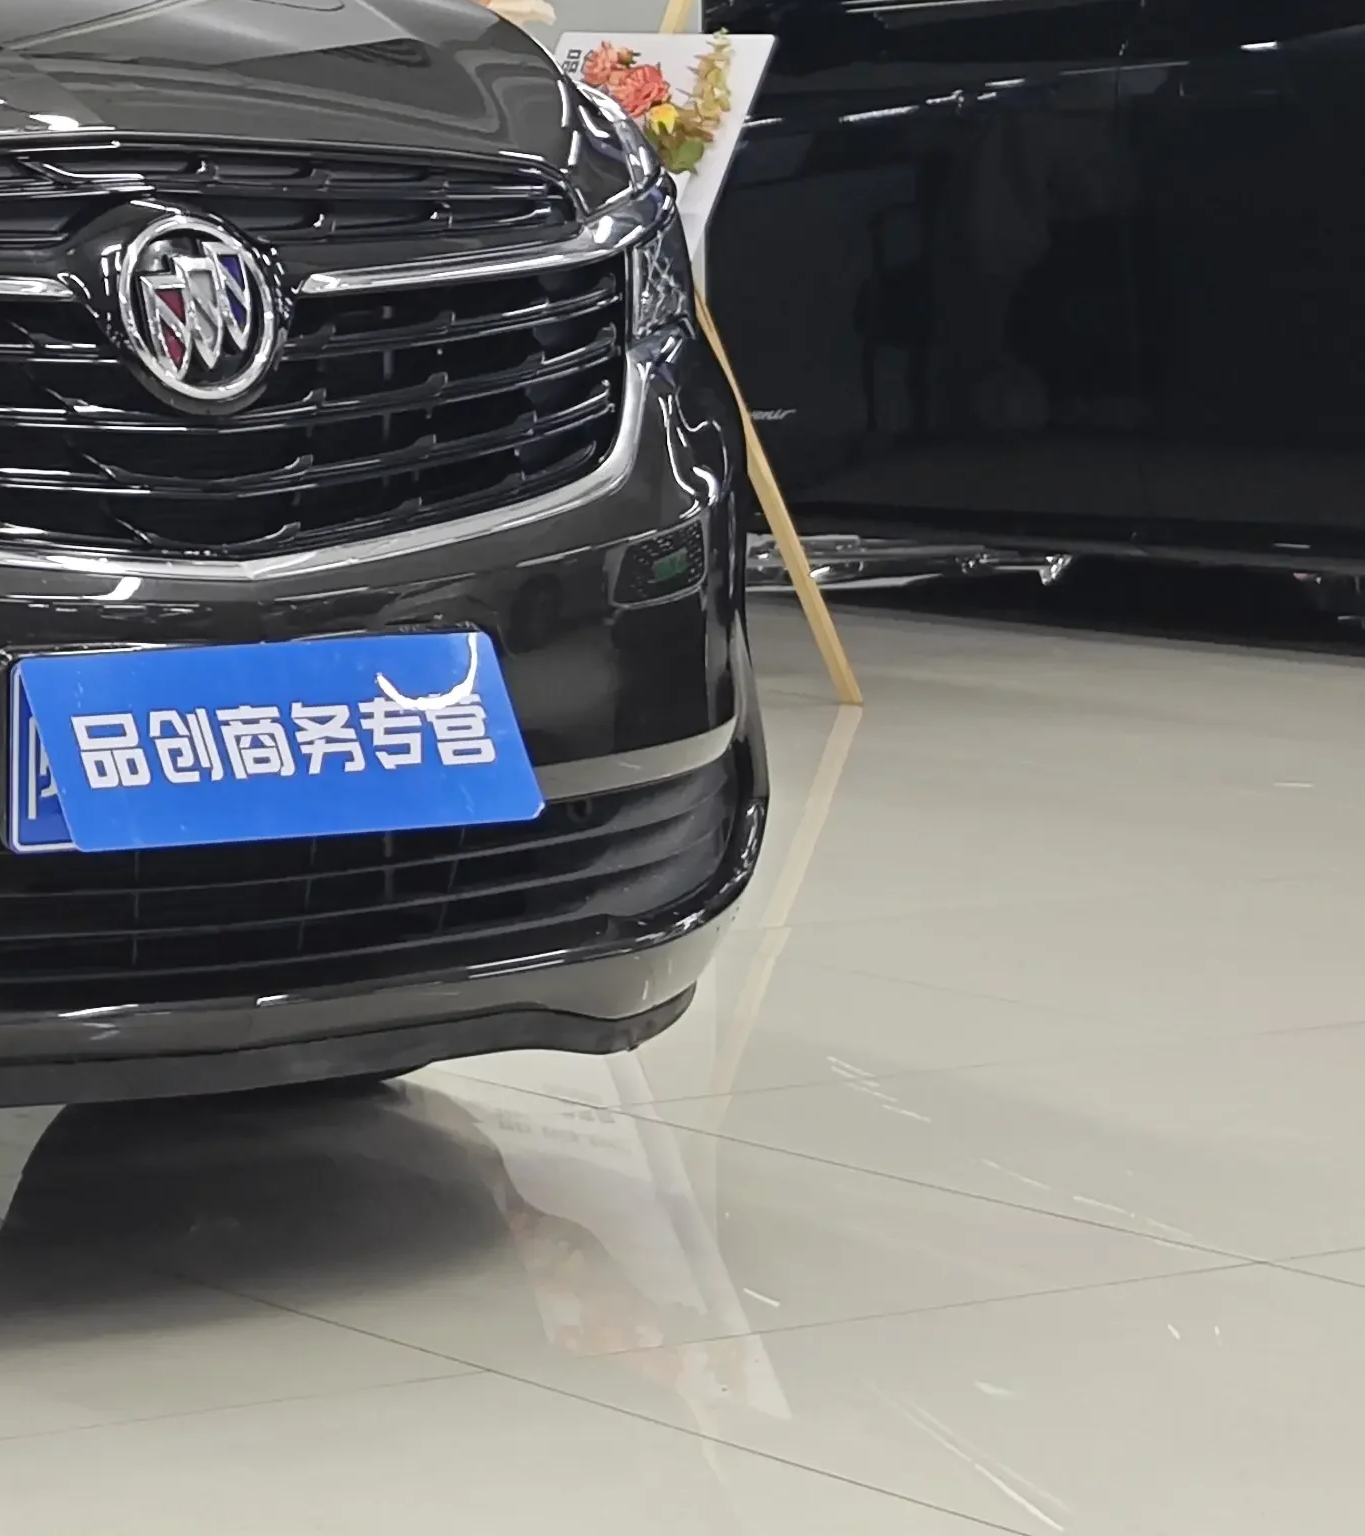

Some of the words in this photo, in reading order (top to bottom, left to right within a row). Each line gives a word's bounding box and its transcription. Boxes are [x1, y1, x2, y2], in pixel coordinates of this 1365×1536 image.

[69, 691, 497, 791] 品创商务专营
